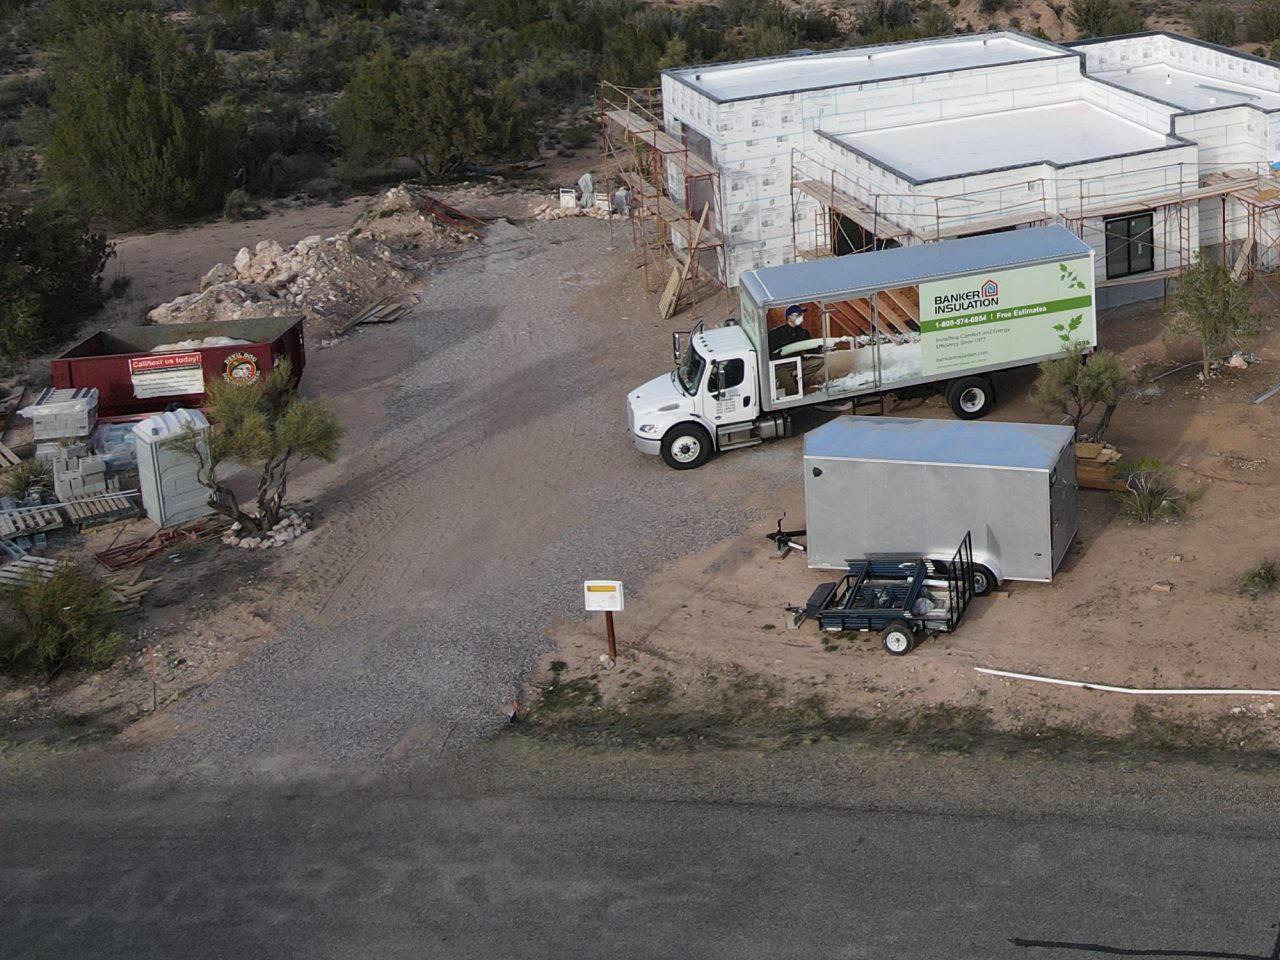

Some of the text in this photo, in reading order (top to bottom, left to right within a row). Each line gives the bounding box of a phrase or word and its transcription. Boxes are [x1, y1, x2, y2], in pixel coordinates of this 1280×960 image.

[934, 290, 981, 305] BANKER
[934, 298, 999, 314] INSULATION
[997, 311, 1012, 319] Free
[1013, 306, 1047, 316] Estimates
[176, 355, 199, 364] today!
[224, 352, 258, 364] DEVIL DOG
